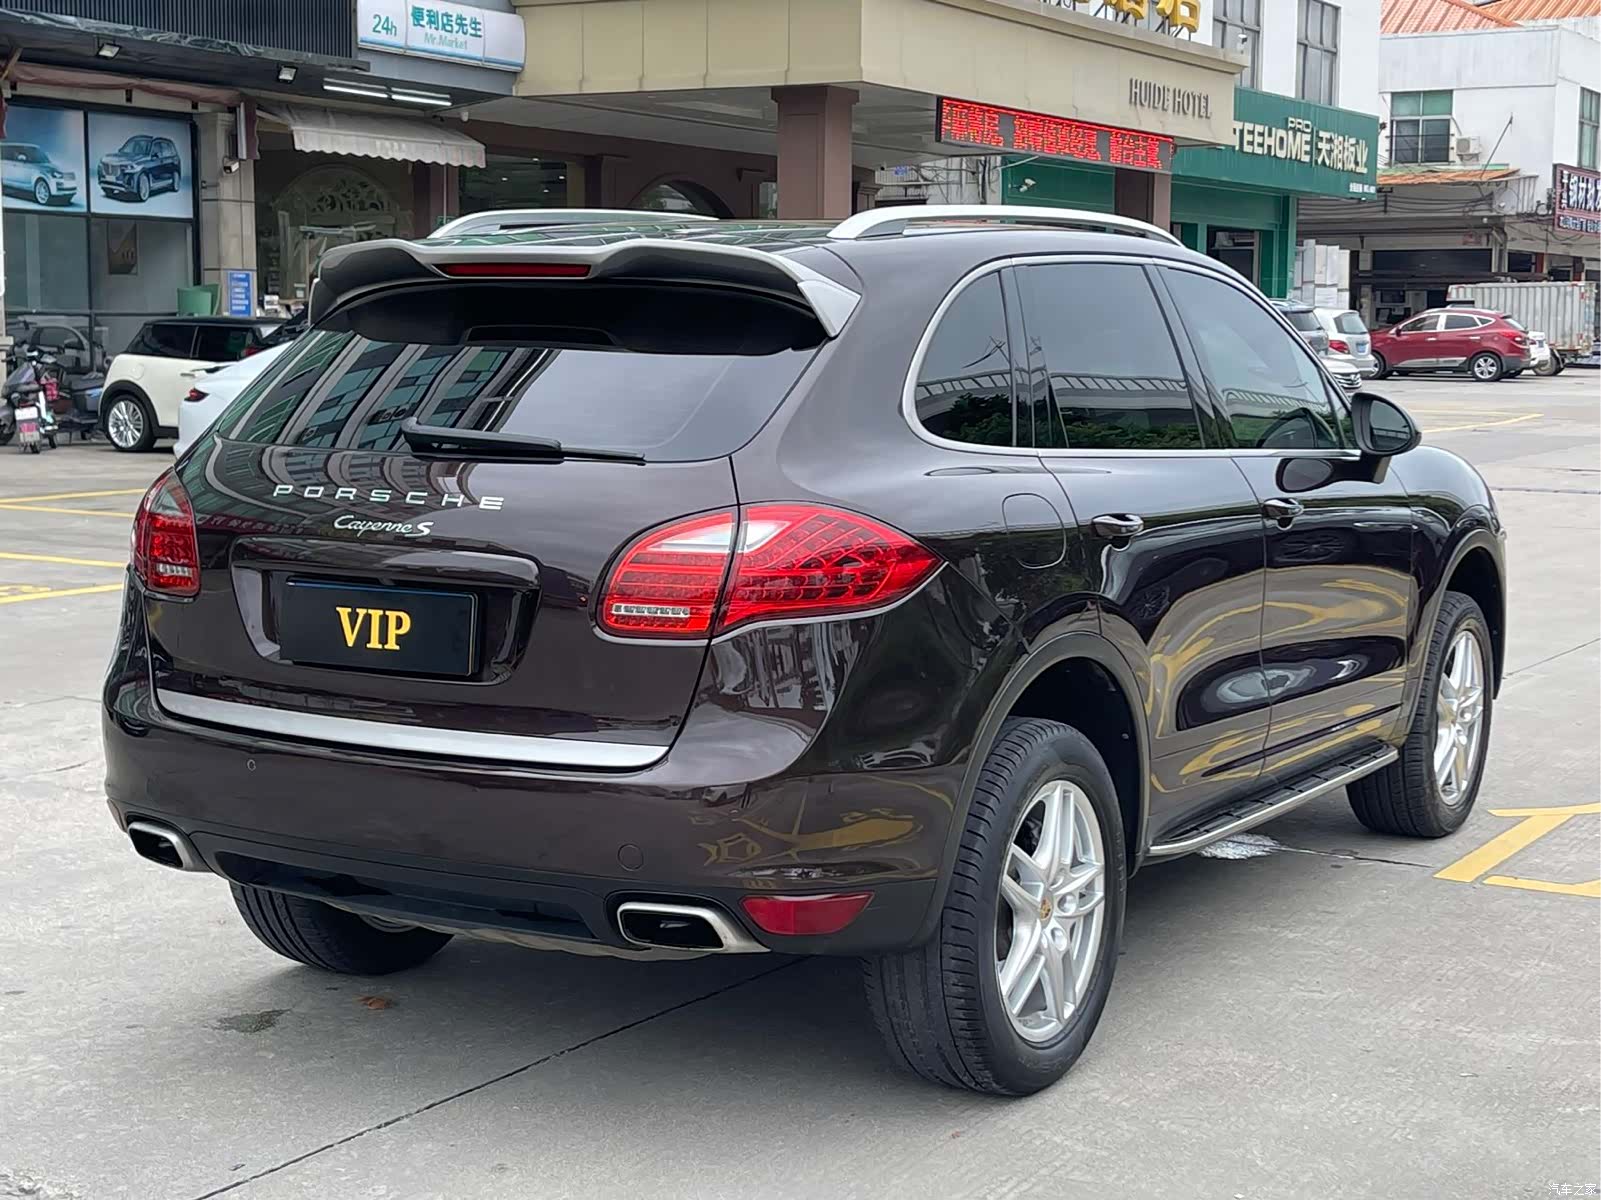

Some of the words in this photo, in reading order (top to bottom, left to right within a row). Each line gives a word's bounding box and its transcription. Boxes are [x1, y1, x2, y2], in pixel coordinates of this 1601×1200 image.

[372, 14, 397, 37] 24h
[411, 5, 482, 38] 便利店先生
[1128, 77, 1170, 112] HUIDE
[1172, 87, 1211, 120] HOTEL
[1287, 116, 1312, 132] PRO
[1233, 120, 1312, 162] TEEHOME
[1317, 130, 1369, 174] 天湘板业
[273, 484, 505, 511] PORSCHE
[333, 514, 412, 538] Cayenne
[336, 606, 412, 650] VIP
